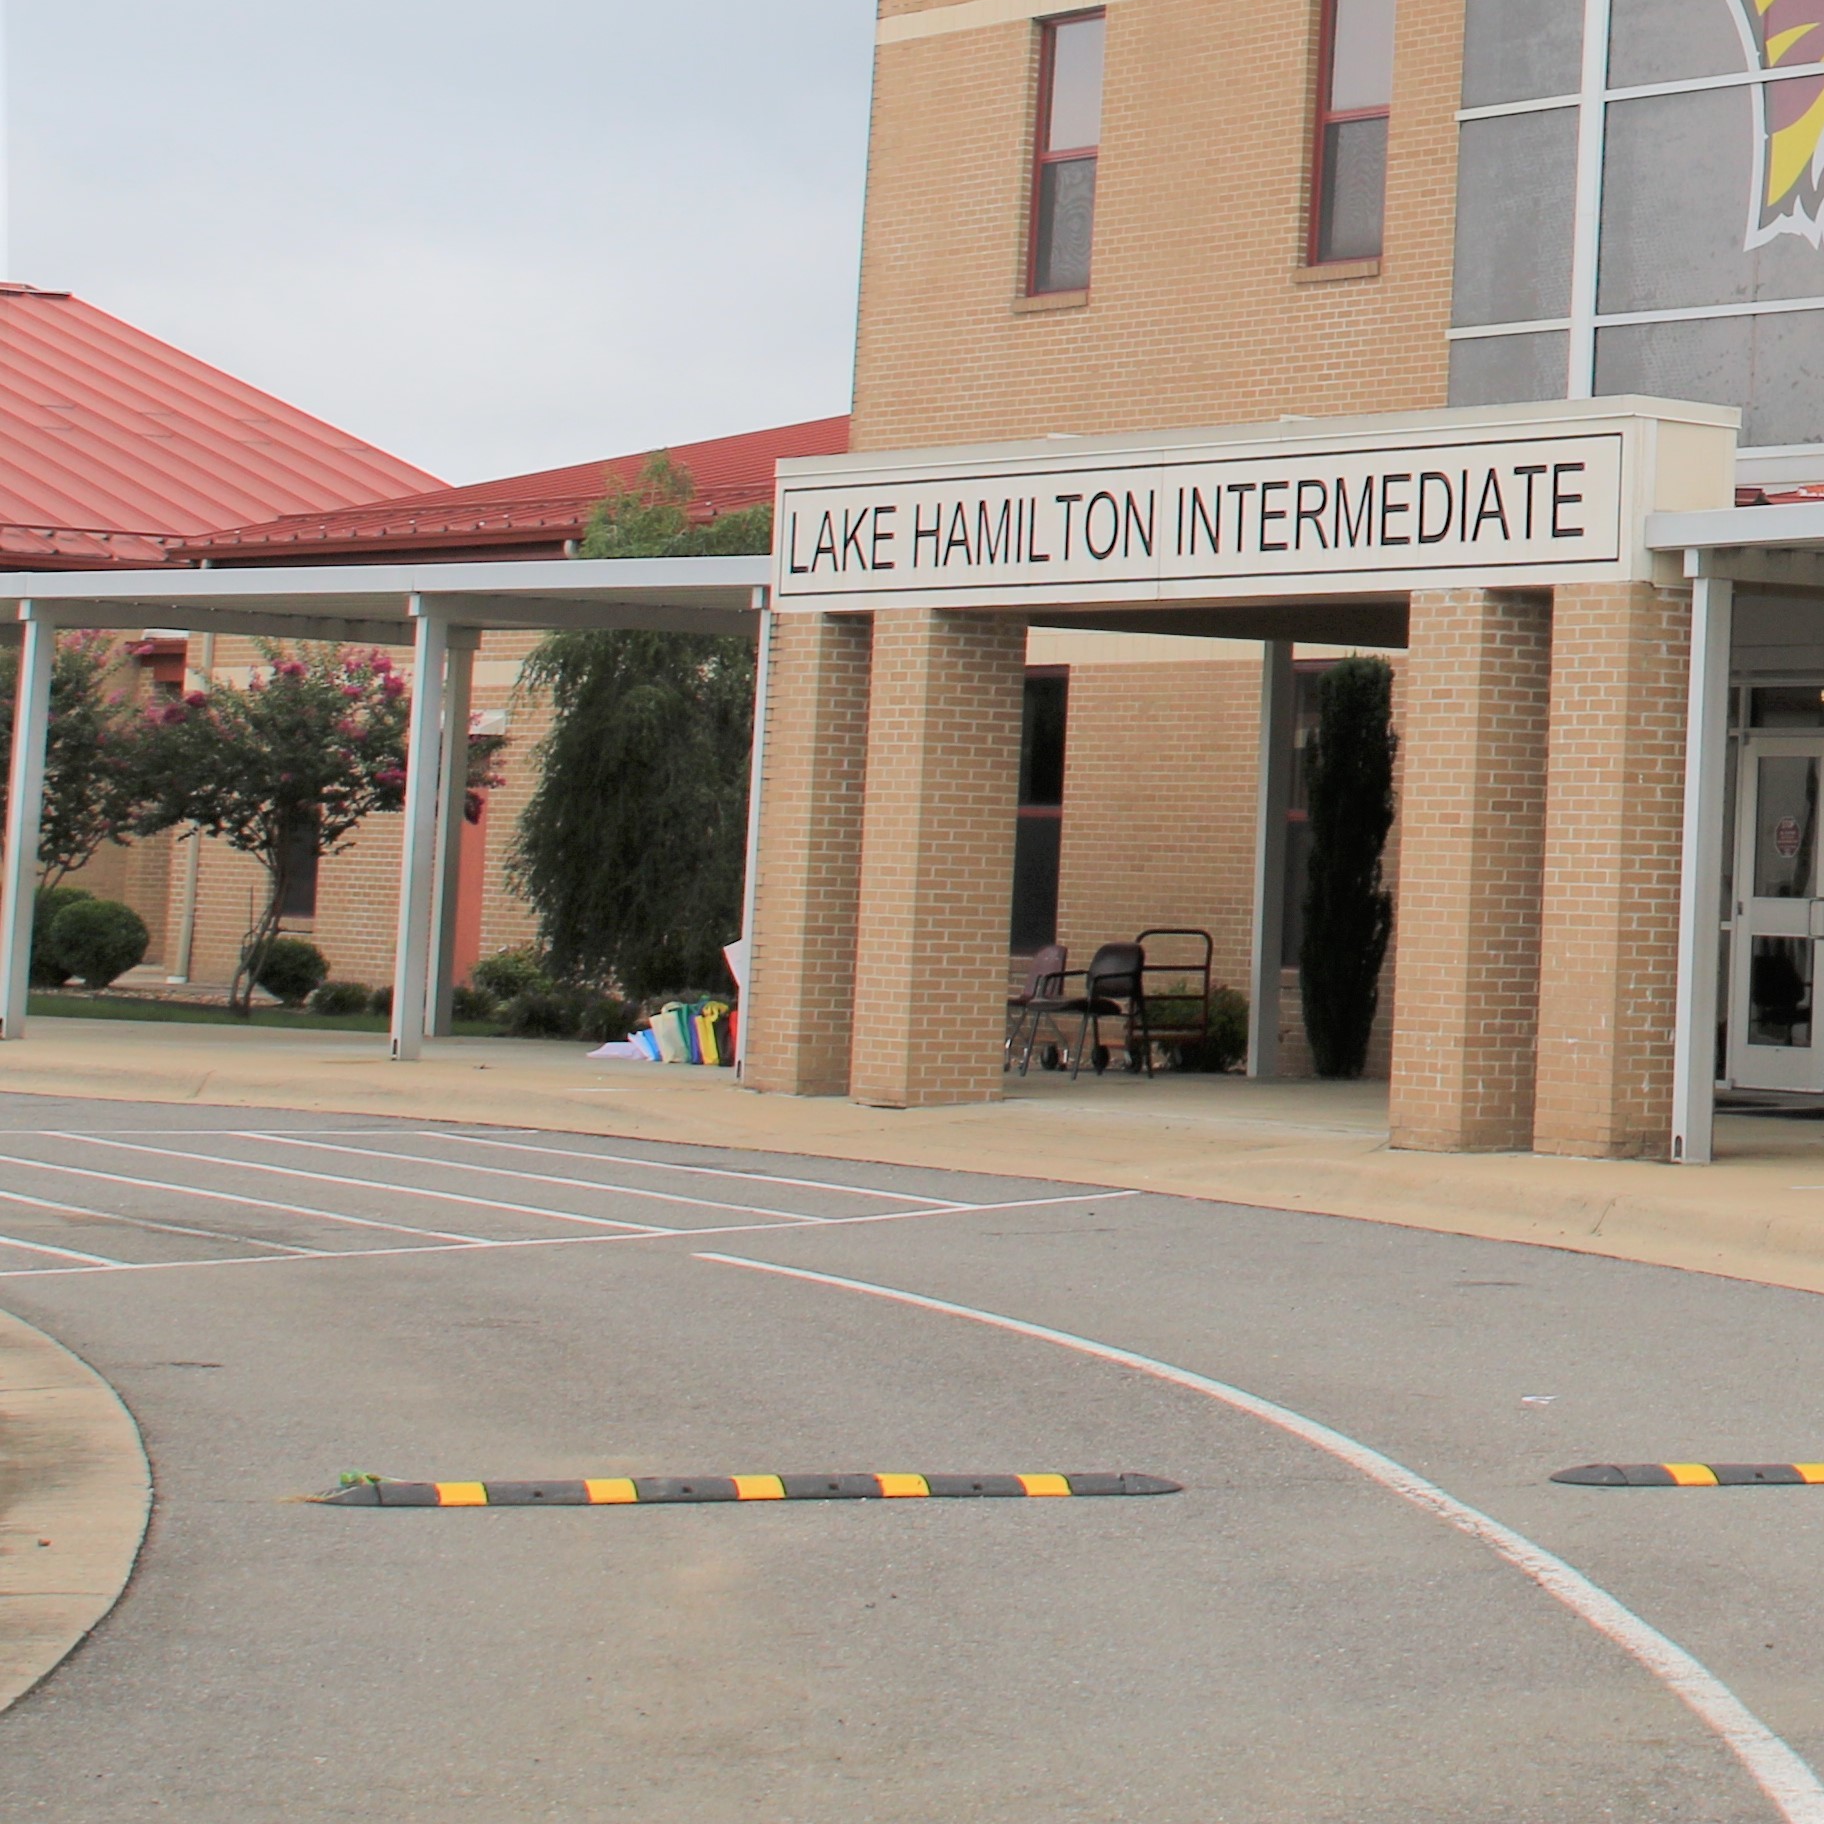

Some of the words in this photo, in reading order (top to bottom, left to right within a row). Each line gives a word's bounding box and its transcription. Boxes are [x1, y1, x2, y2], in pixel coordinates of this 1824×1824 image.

[790, 506, 897, 574] LAKE
[914, 488, 1155, 568] HAMILTON
[1177, 462, 1585, 557] INTERMEDIATE
